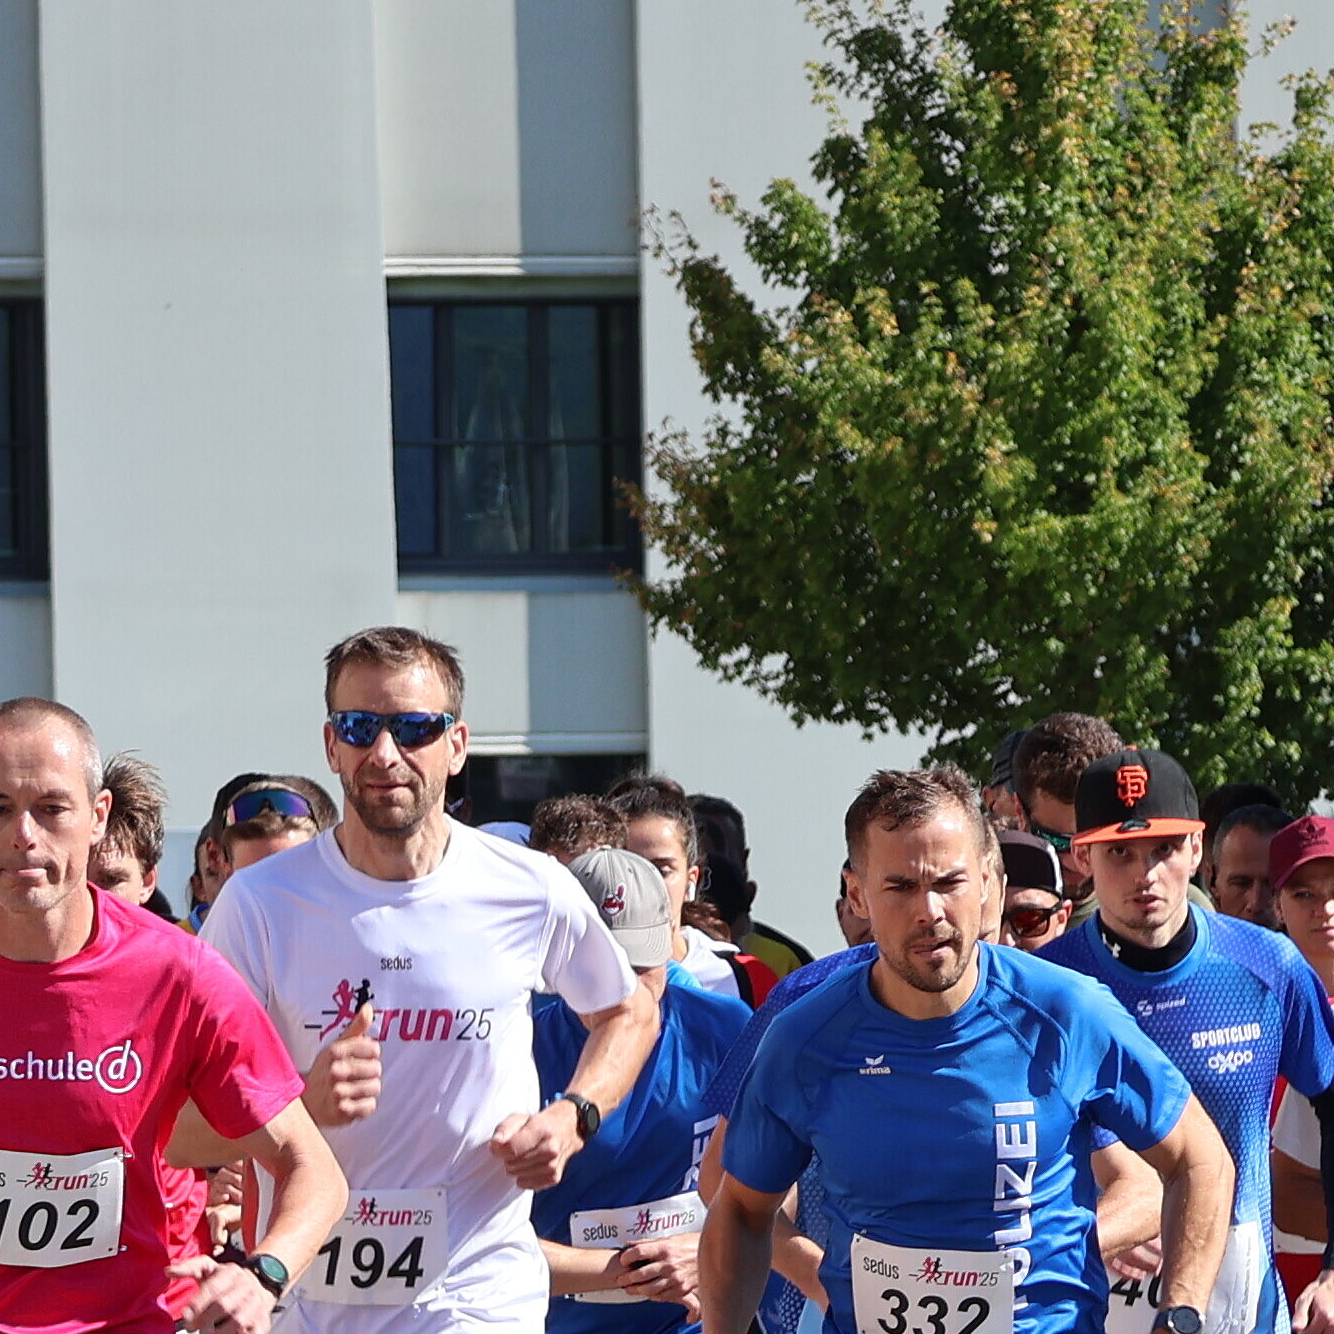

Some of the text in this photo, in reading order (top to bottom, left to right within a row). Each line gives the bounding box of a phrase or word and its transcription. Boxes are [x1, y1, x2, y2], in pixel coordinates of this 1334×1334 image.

[380, 955, 413, 971] sedus
[1191, 1022, 1261, 1050] SPORTCLUB
[582, 1222, 618, 1241] sedus
[317, 1235, 425, 1289] 194
[863, 1255, 900, 1280] sedus
